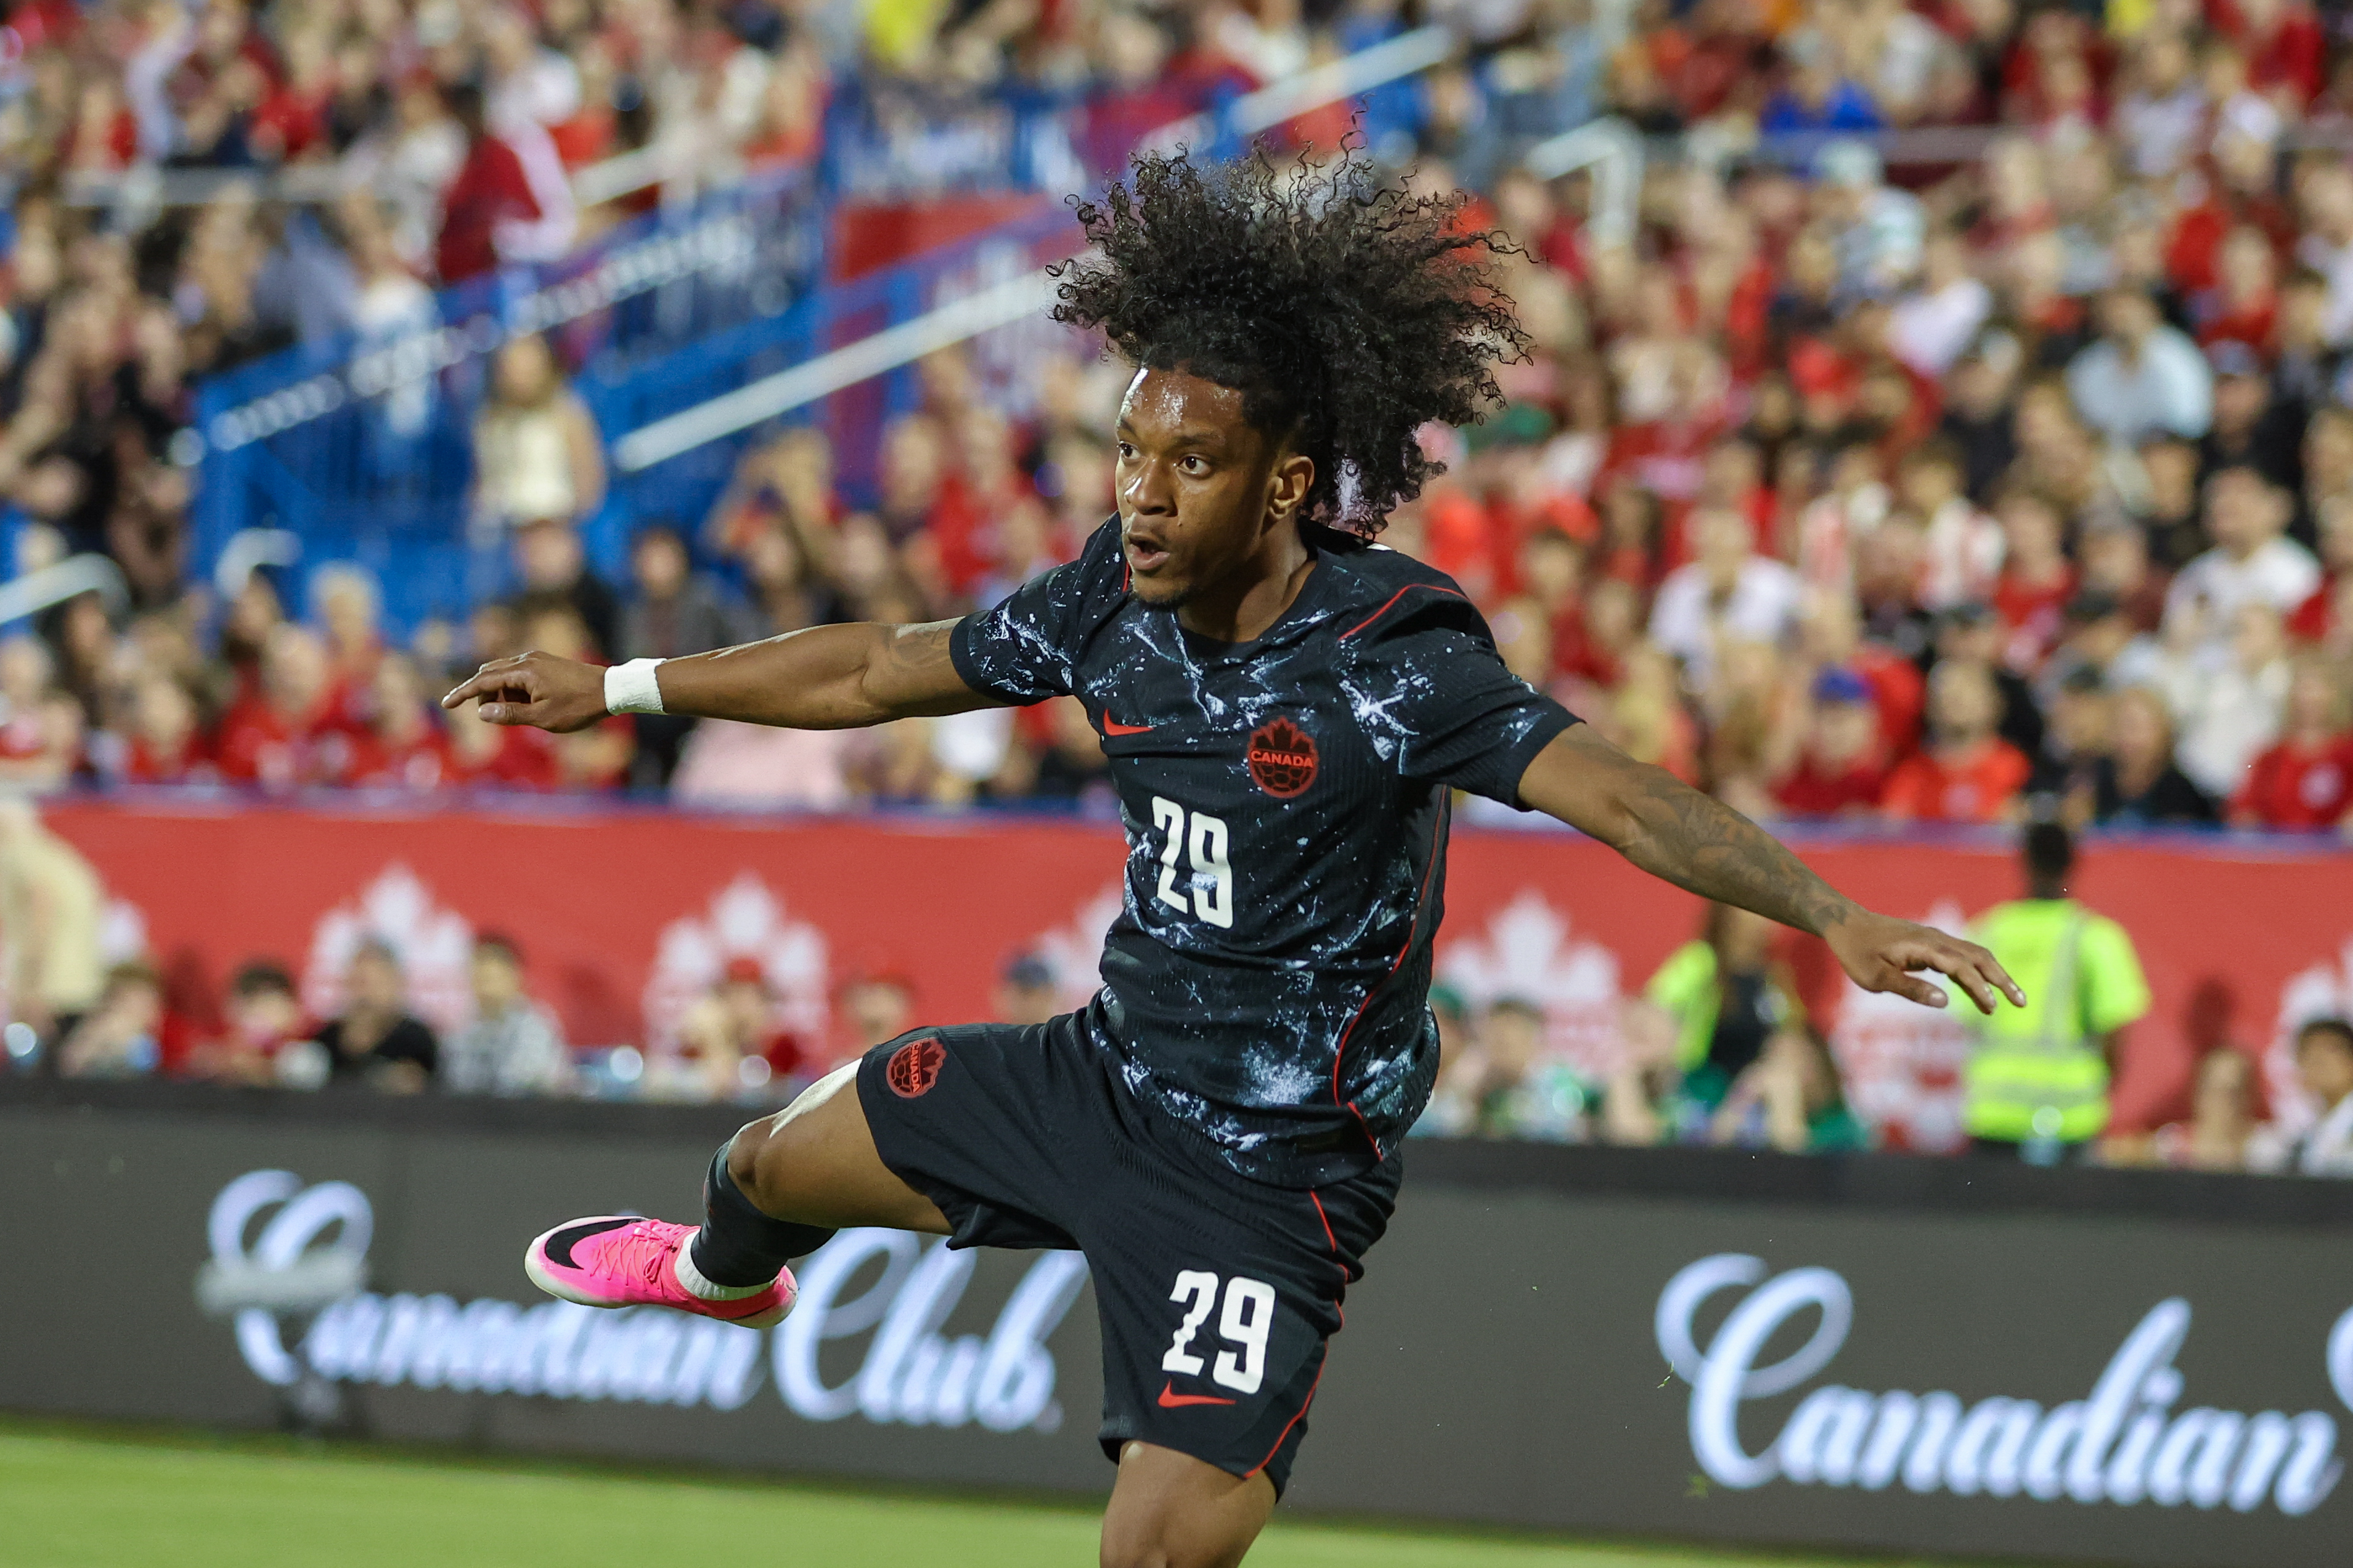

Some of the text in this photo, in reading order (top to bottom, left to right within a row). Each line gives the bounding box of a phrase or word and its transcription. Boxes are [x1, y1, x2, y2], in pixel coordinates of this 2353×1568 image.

[1249, 750, 1314, 768] CANADA
[1152, 796, 1233, 929] 29
[910, 1043, 921, 1093] CANADA
[772, 1227, 1090, 1433] Club
[1162, 1269, 1276, 1395] 29
[1655, 1252, 2344, 1516] Canadian
